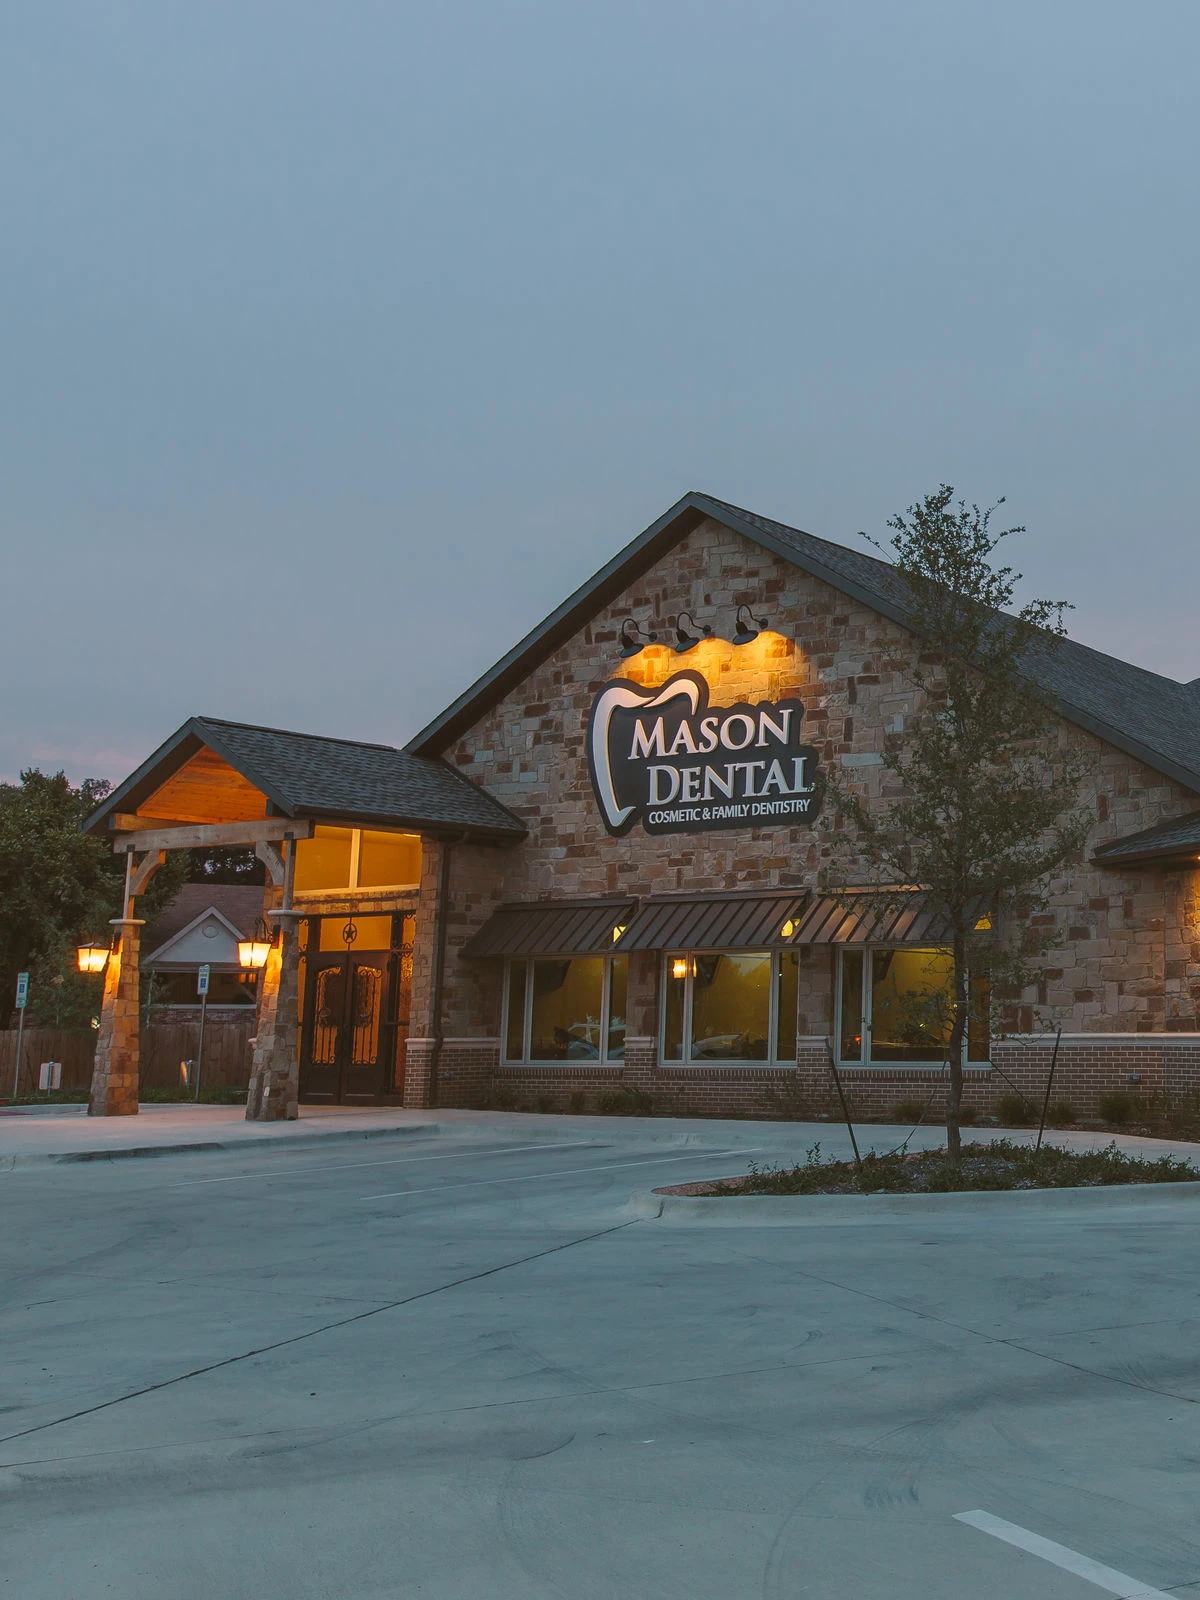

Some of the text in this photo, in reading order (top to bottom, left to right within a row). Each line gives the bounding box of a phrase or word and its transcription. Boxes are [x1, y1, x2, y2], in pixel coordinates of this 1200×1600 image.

[627, 708, 794, 760] MASON
[646, 756, 816, 806] DENTAL
[648, 799, 811, 824] COSMETIC & FAMILY DENTISTRY
